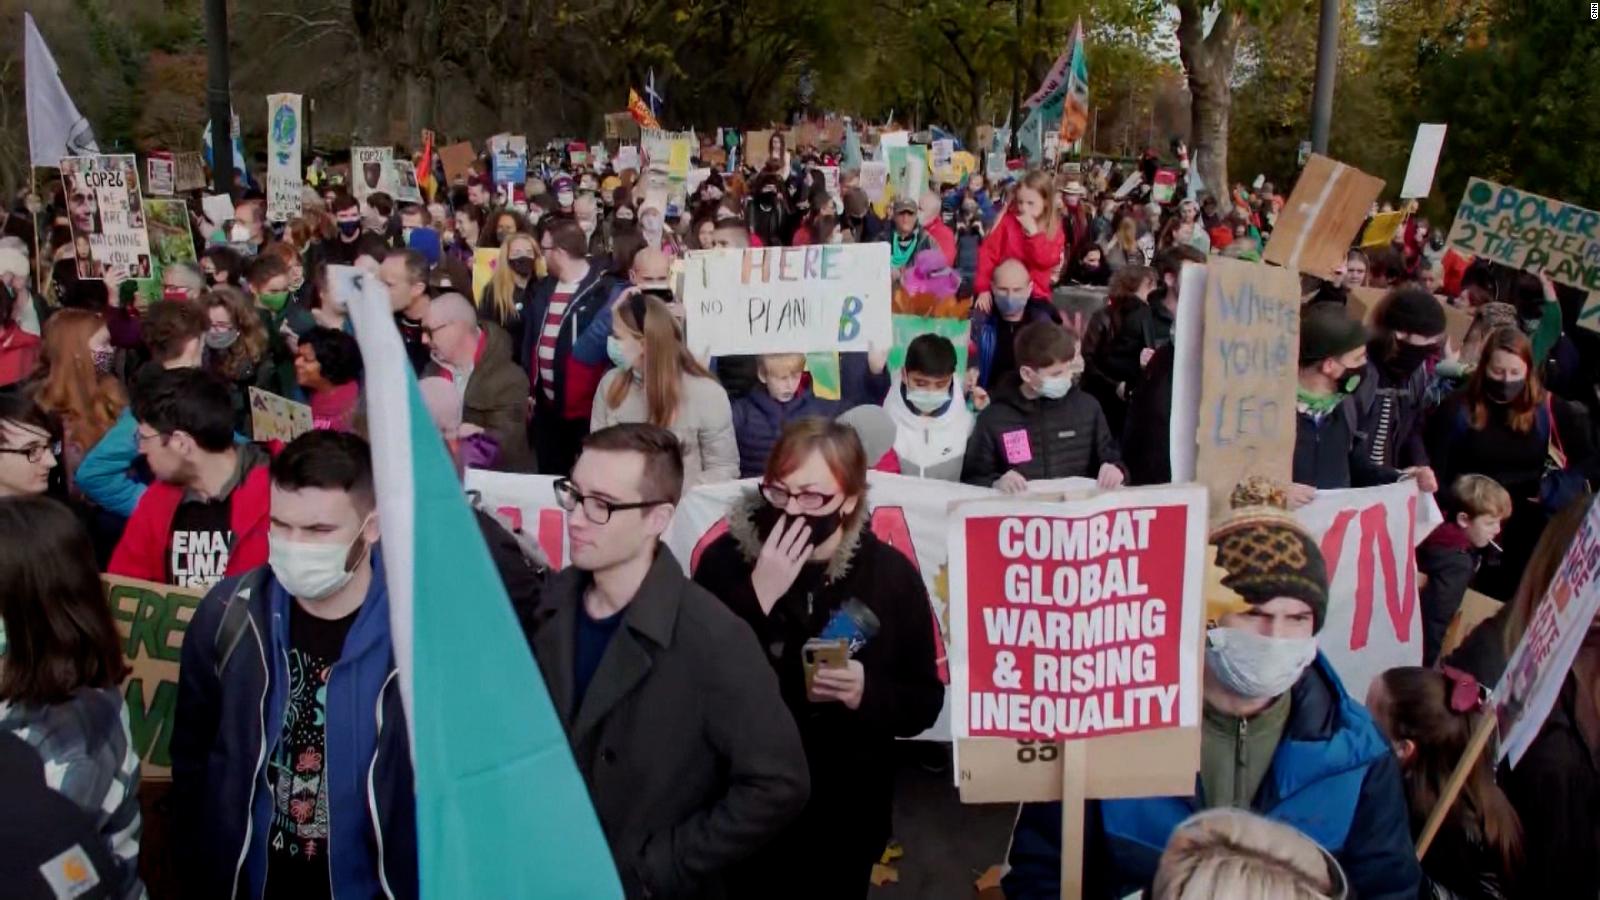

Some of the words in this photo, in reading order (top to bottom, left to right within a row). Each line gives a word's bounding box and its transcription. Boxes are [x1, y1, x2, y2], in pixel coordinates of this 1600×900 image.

[84, 171, 124, 189] COP26
[1453, 223, 1477, 251] 2
[1494, 186, 1599, 239] POWER
[701, 301, 724, 318] NO
[838, 295, 863, 342] B
[1212, 394, 1280, 447] LEO
[998, 508, 1157, 561] COMBAT
[1004, 556, 1149, 607] GLOBAL
[982, 598, 1168, 650] WARMING
[992, 650, 1023, 690] &
[1033, 643, 1156, 694] RISING
[968, 684, 1180, 739] INEQUALITY
